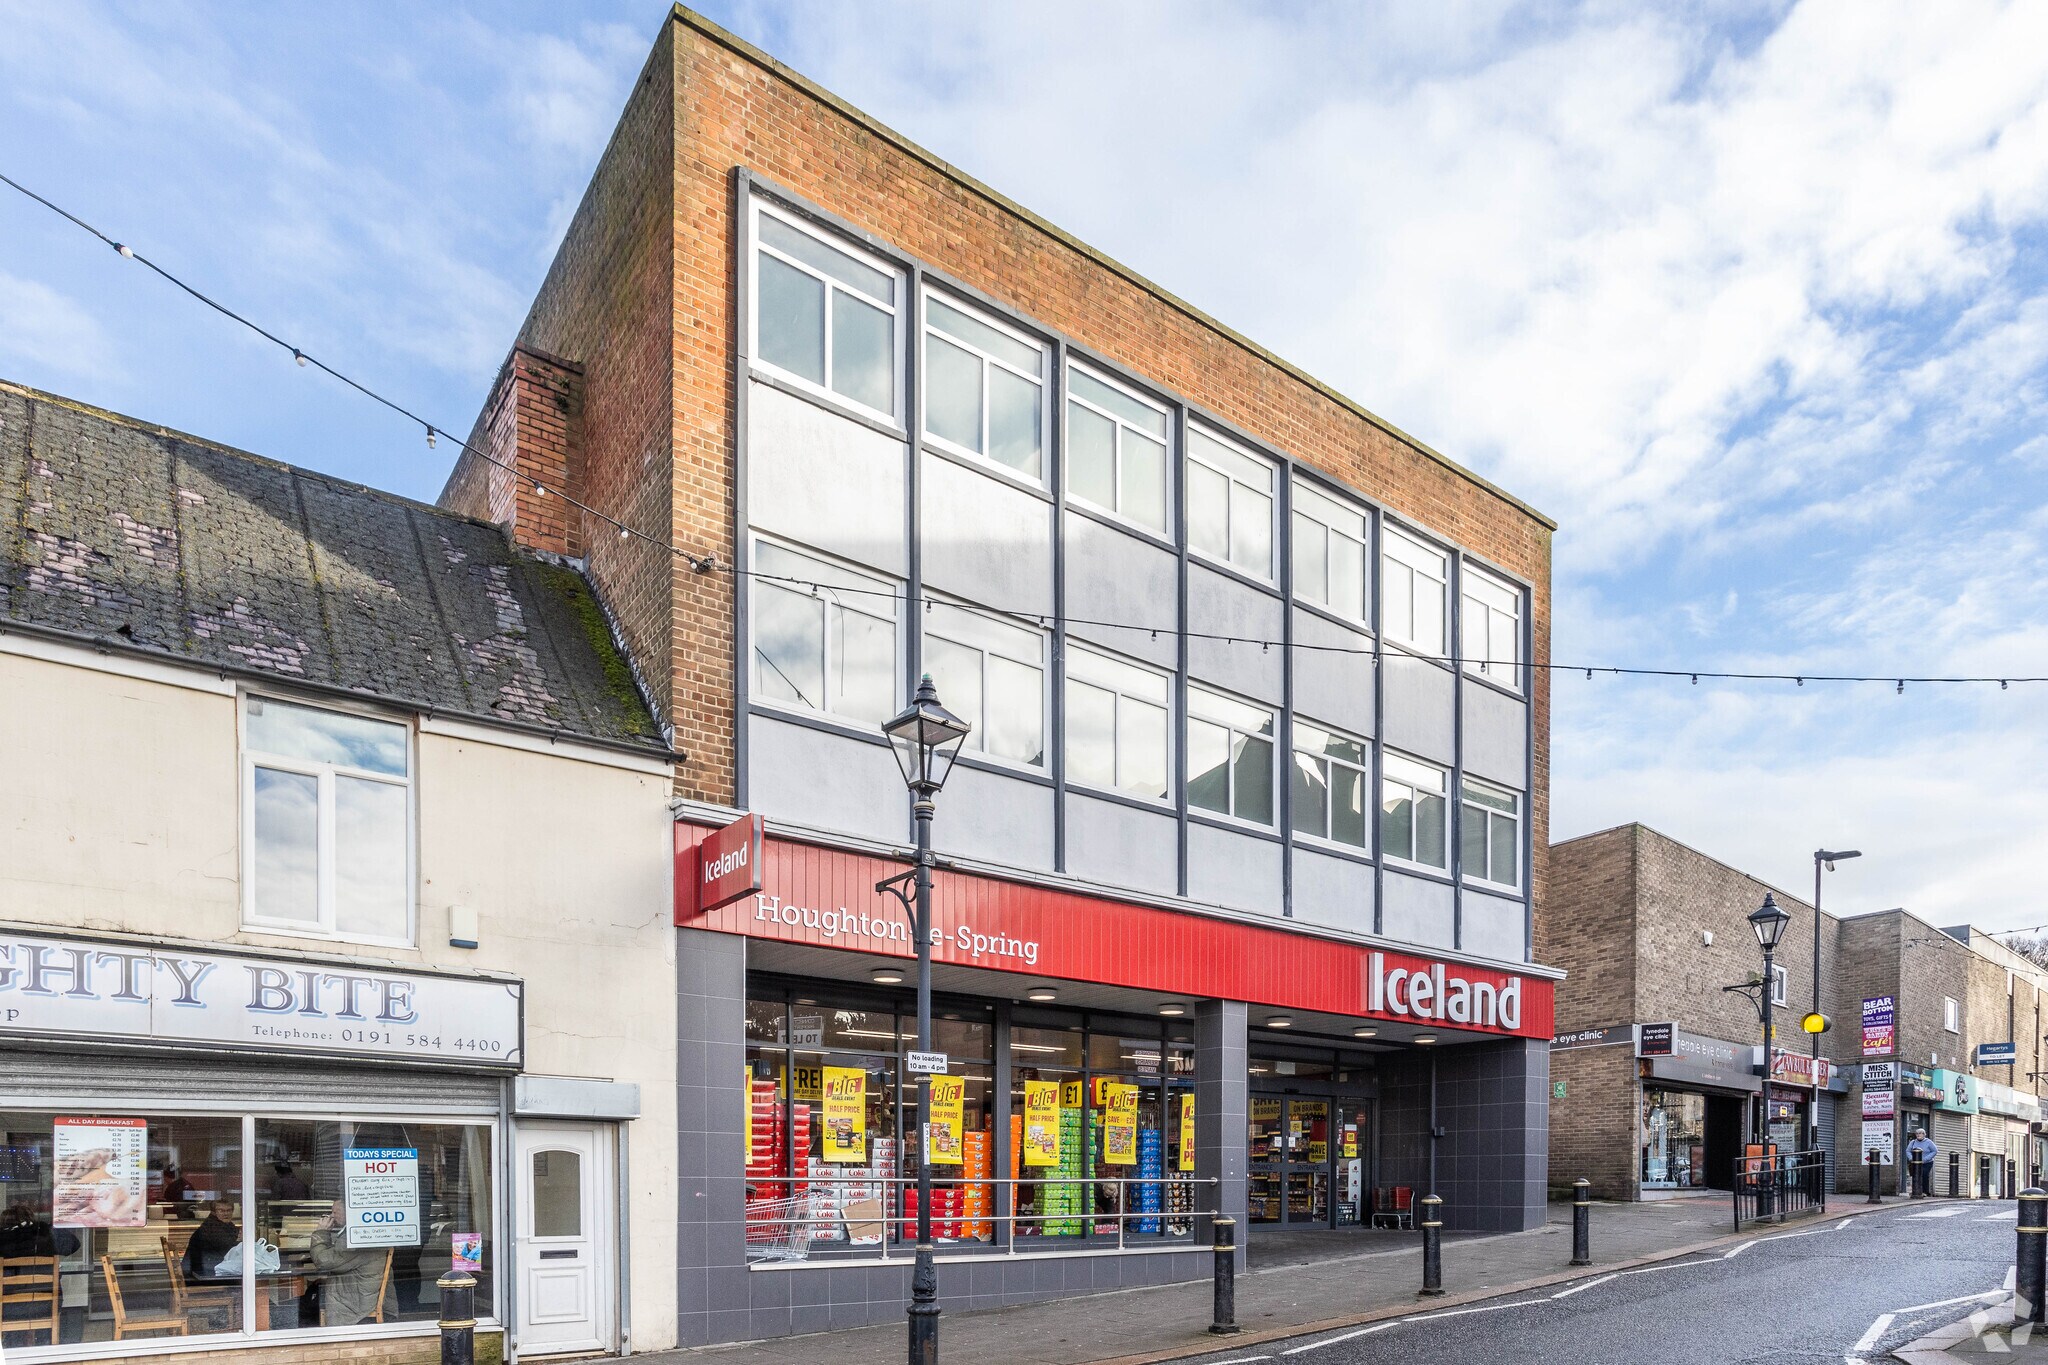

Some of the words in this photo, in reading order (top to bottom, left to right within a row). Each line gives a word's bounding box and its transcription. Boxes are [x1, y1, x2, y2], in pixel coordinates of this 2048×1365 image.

[705, 842, 747, 883] Iceland
[755, 894, 1039, 964] Houghtone-Spring
[0, 944, 216, 1008] HTY
[243, 965, 418, 1025] BITE
[1368, 952, 1521, 1030] Iceland
[1863, 997, 1892, 1010] BEAR
[1862, 1005, 1893, 1016] BOTTOM
[252, 1025, 333, 1040] Telephone:
[342, 1029, 392, 1045] 0191
[406, 1034, 441, 1048] 584
[454, 1037, 501, 1052] 4400
[1560, 1034, 1576, 1044] eye
[1579, 1030, 1602, 1041] clinic
[1863, 1037, 1888, 1047] Café
[922, 1055, 944, 1063] loading
[832, 1079, 857, 1095] BIG
[934, 1086, 957, 1102] BIG
[1032, 1091, 1052, 1106] BIG
[1066, 1085, 1078, 1103] £1
[1114, 1093, 1131, 1107] BIG
[1261, 1106, 1280, 1114] BRANDS
[1302, 1103, 1323, 1112] BRANDS
[944, 1111, 958, 1119] PRICE
[881, 1139, 895, 1147] Cok
[348, 1150, 379, 1158] TODAYS
[381, 1150, 414, 1158] SPECIAL
[365, 1162, 397, 1173] HOT
[848, 1189, 866, 1197] Coke
[361, 1211, 405, 1223] COLD
[816, 1210, 835, 1218] Coke
[815, 1231, 833, 1239] Coke
